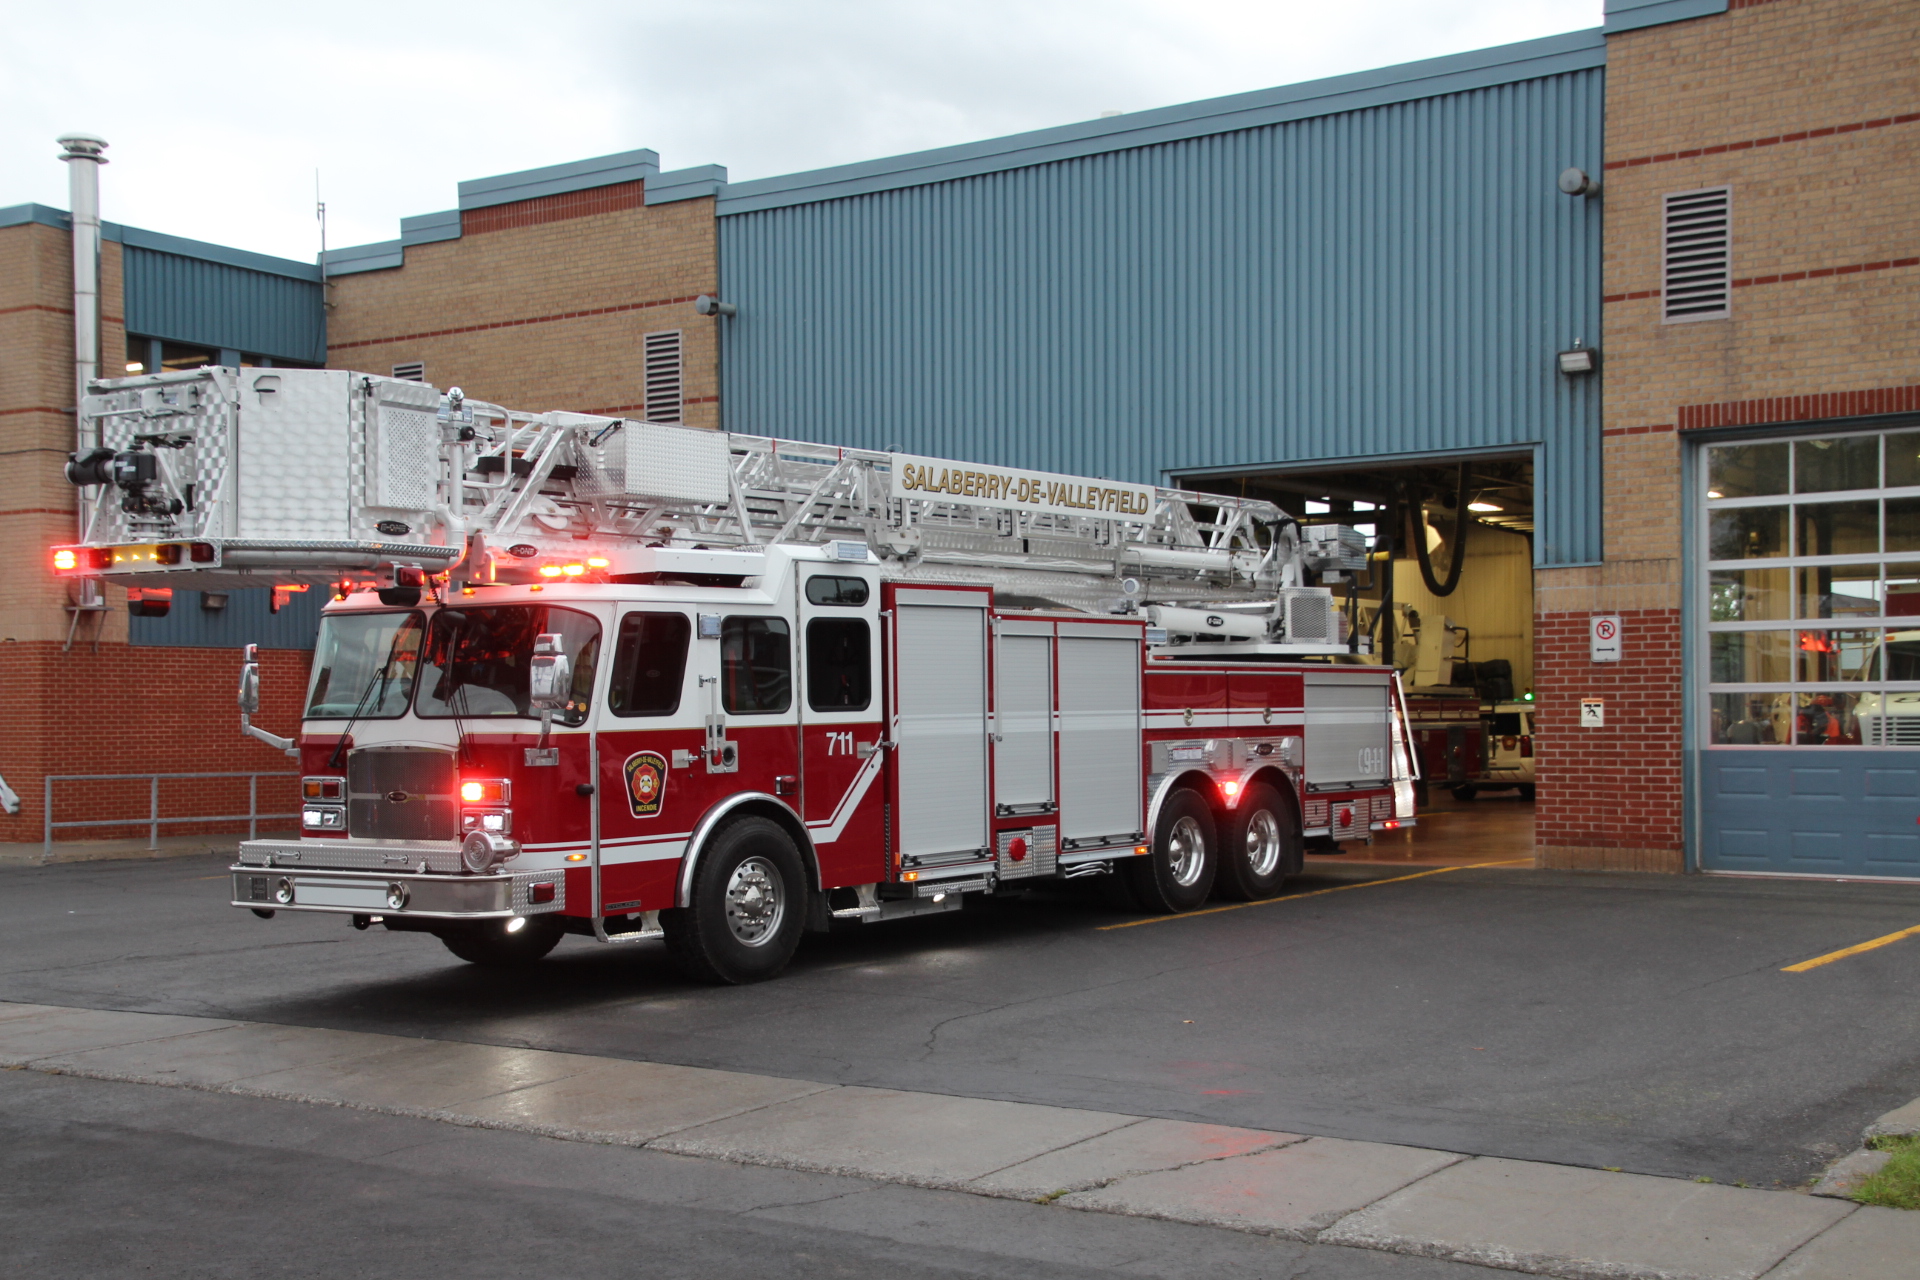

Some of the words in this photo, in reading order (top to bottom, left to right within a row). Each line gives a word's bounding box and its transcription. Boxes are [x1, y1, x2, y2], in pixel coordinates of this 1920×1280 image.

[902, 463, 1148, 515] SALABERRY-DE-VALLEYFIELD
[826, 731, 853, 756] 711
[635, 803, 658, 812] INCENDIE
